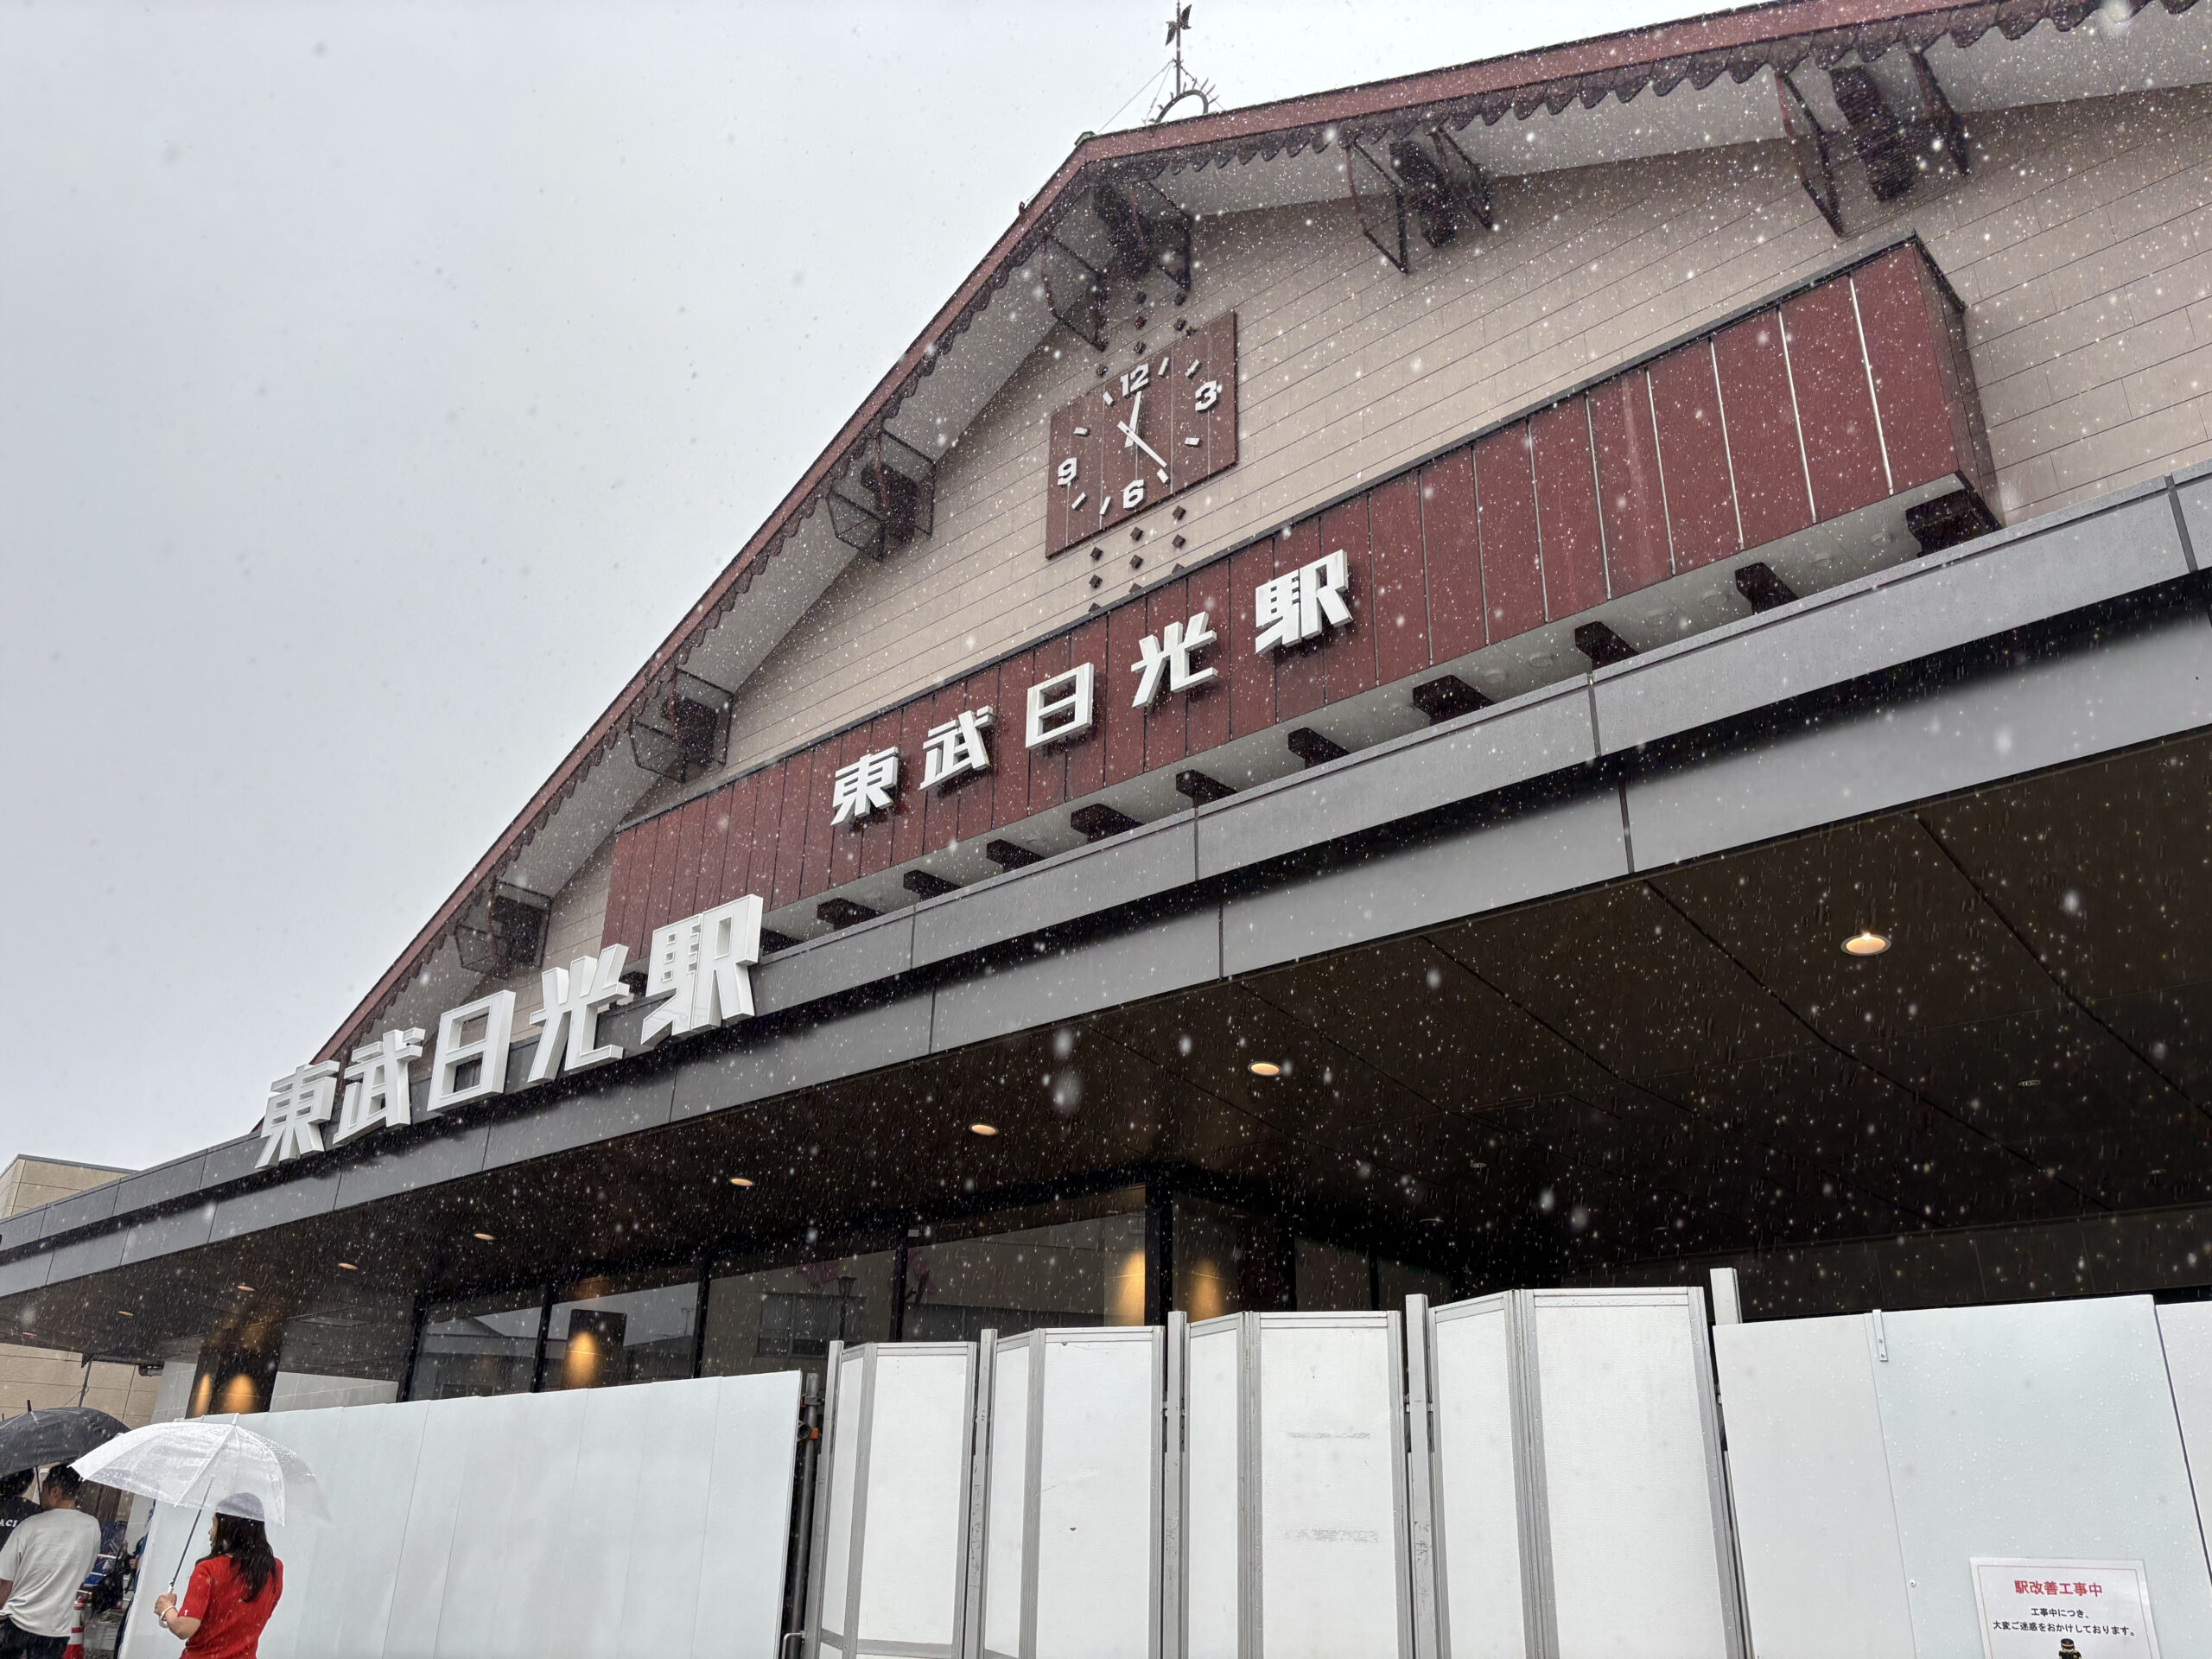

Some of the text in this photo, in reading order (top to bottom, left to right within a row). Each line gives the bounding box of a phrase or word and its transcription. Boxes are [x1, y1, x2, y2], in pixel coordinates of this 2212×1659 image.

[1120, 363, 1149, 397] 12
[1195, 380, 1217, 411] 3
[1058, 457, 1077, 485] 9
[1123, 479, 1144, 509] 6
[831, 550, 1353, 826] 東武日光駅
[255, 893, 764, 1170] 東武日光駅
[2014, 1580, 2103, 1597] 駅改善工事中
[2031, 1608, 2089, 1619] 工事中につき、
[1993, 1621, 2136, 1637] 大変ご迷惑をおかけしております。
